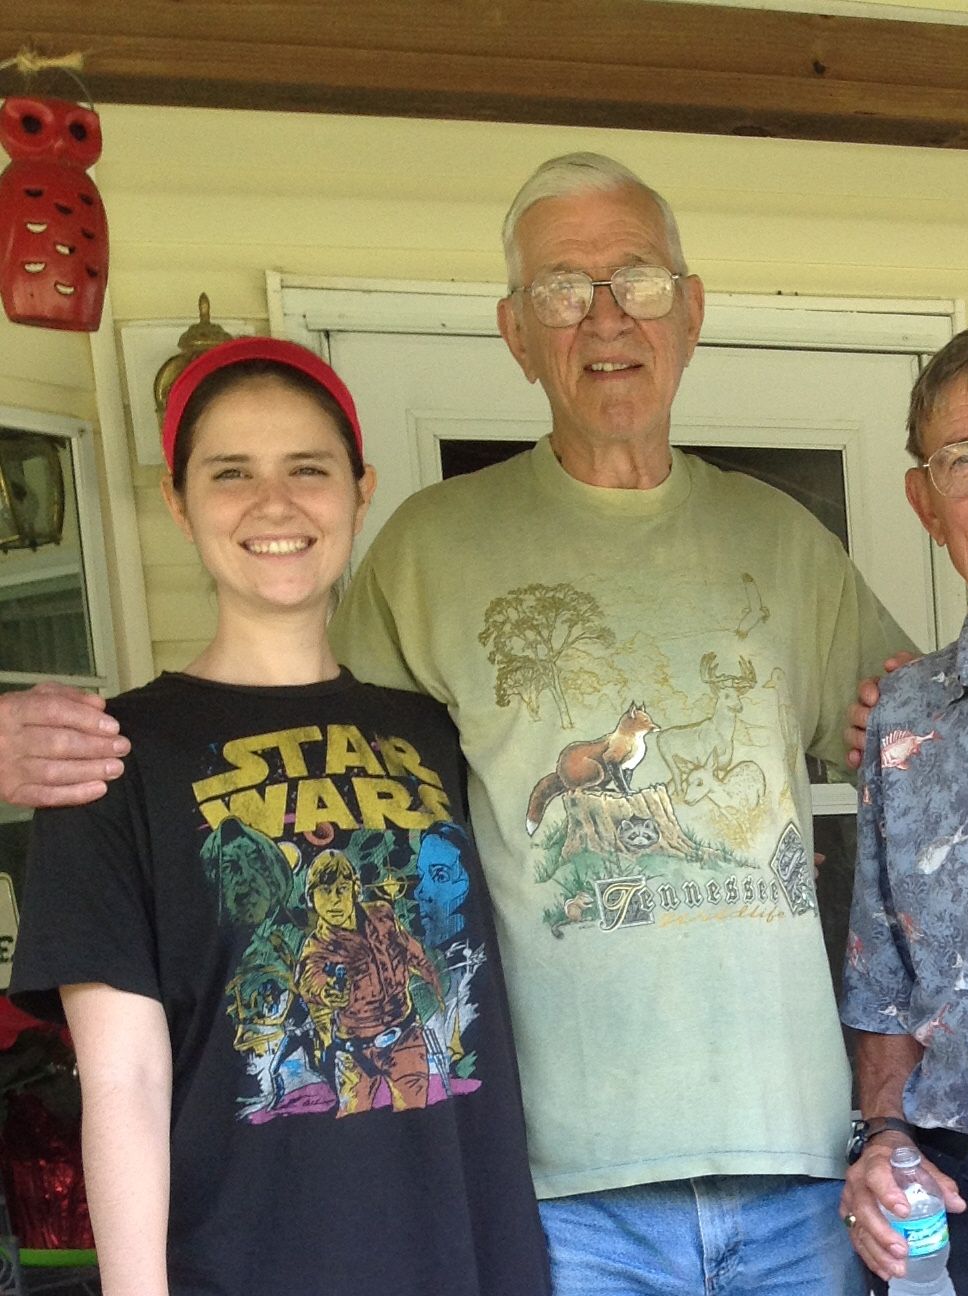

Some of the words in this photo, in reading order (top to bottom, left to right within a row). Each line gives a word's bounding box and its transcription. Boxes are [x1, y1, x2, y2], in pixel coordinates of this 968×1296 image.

[192, 724, 443, 803] STAR
[199, 776, 453, 838] WARS
[600, 875, 780, 933] Tennessee
